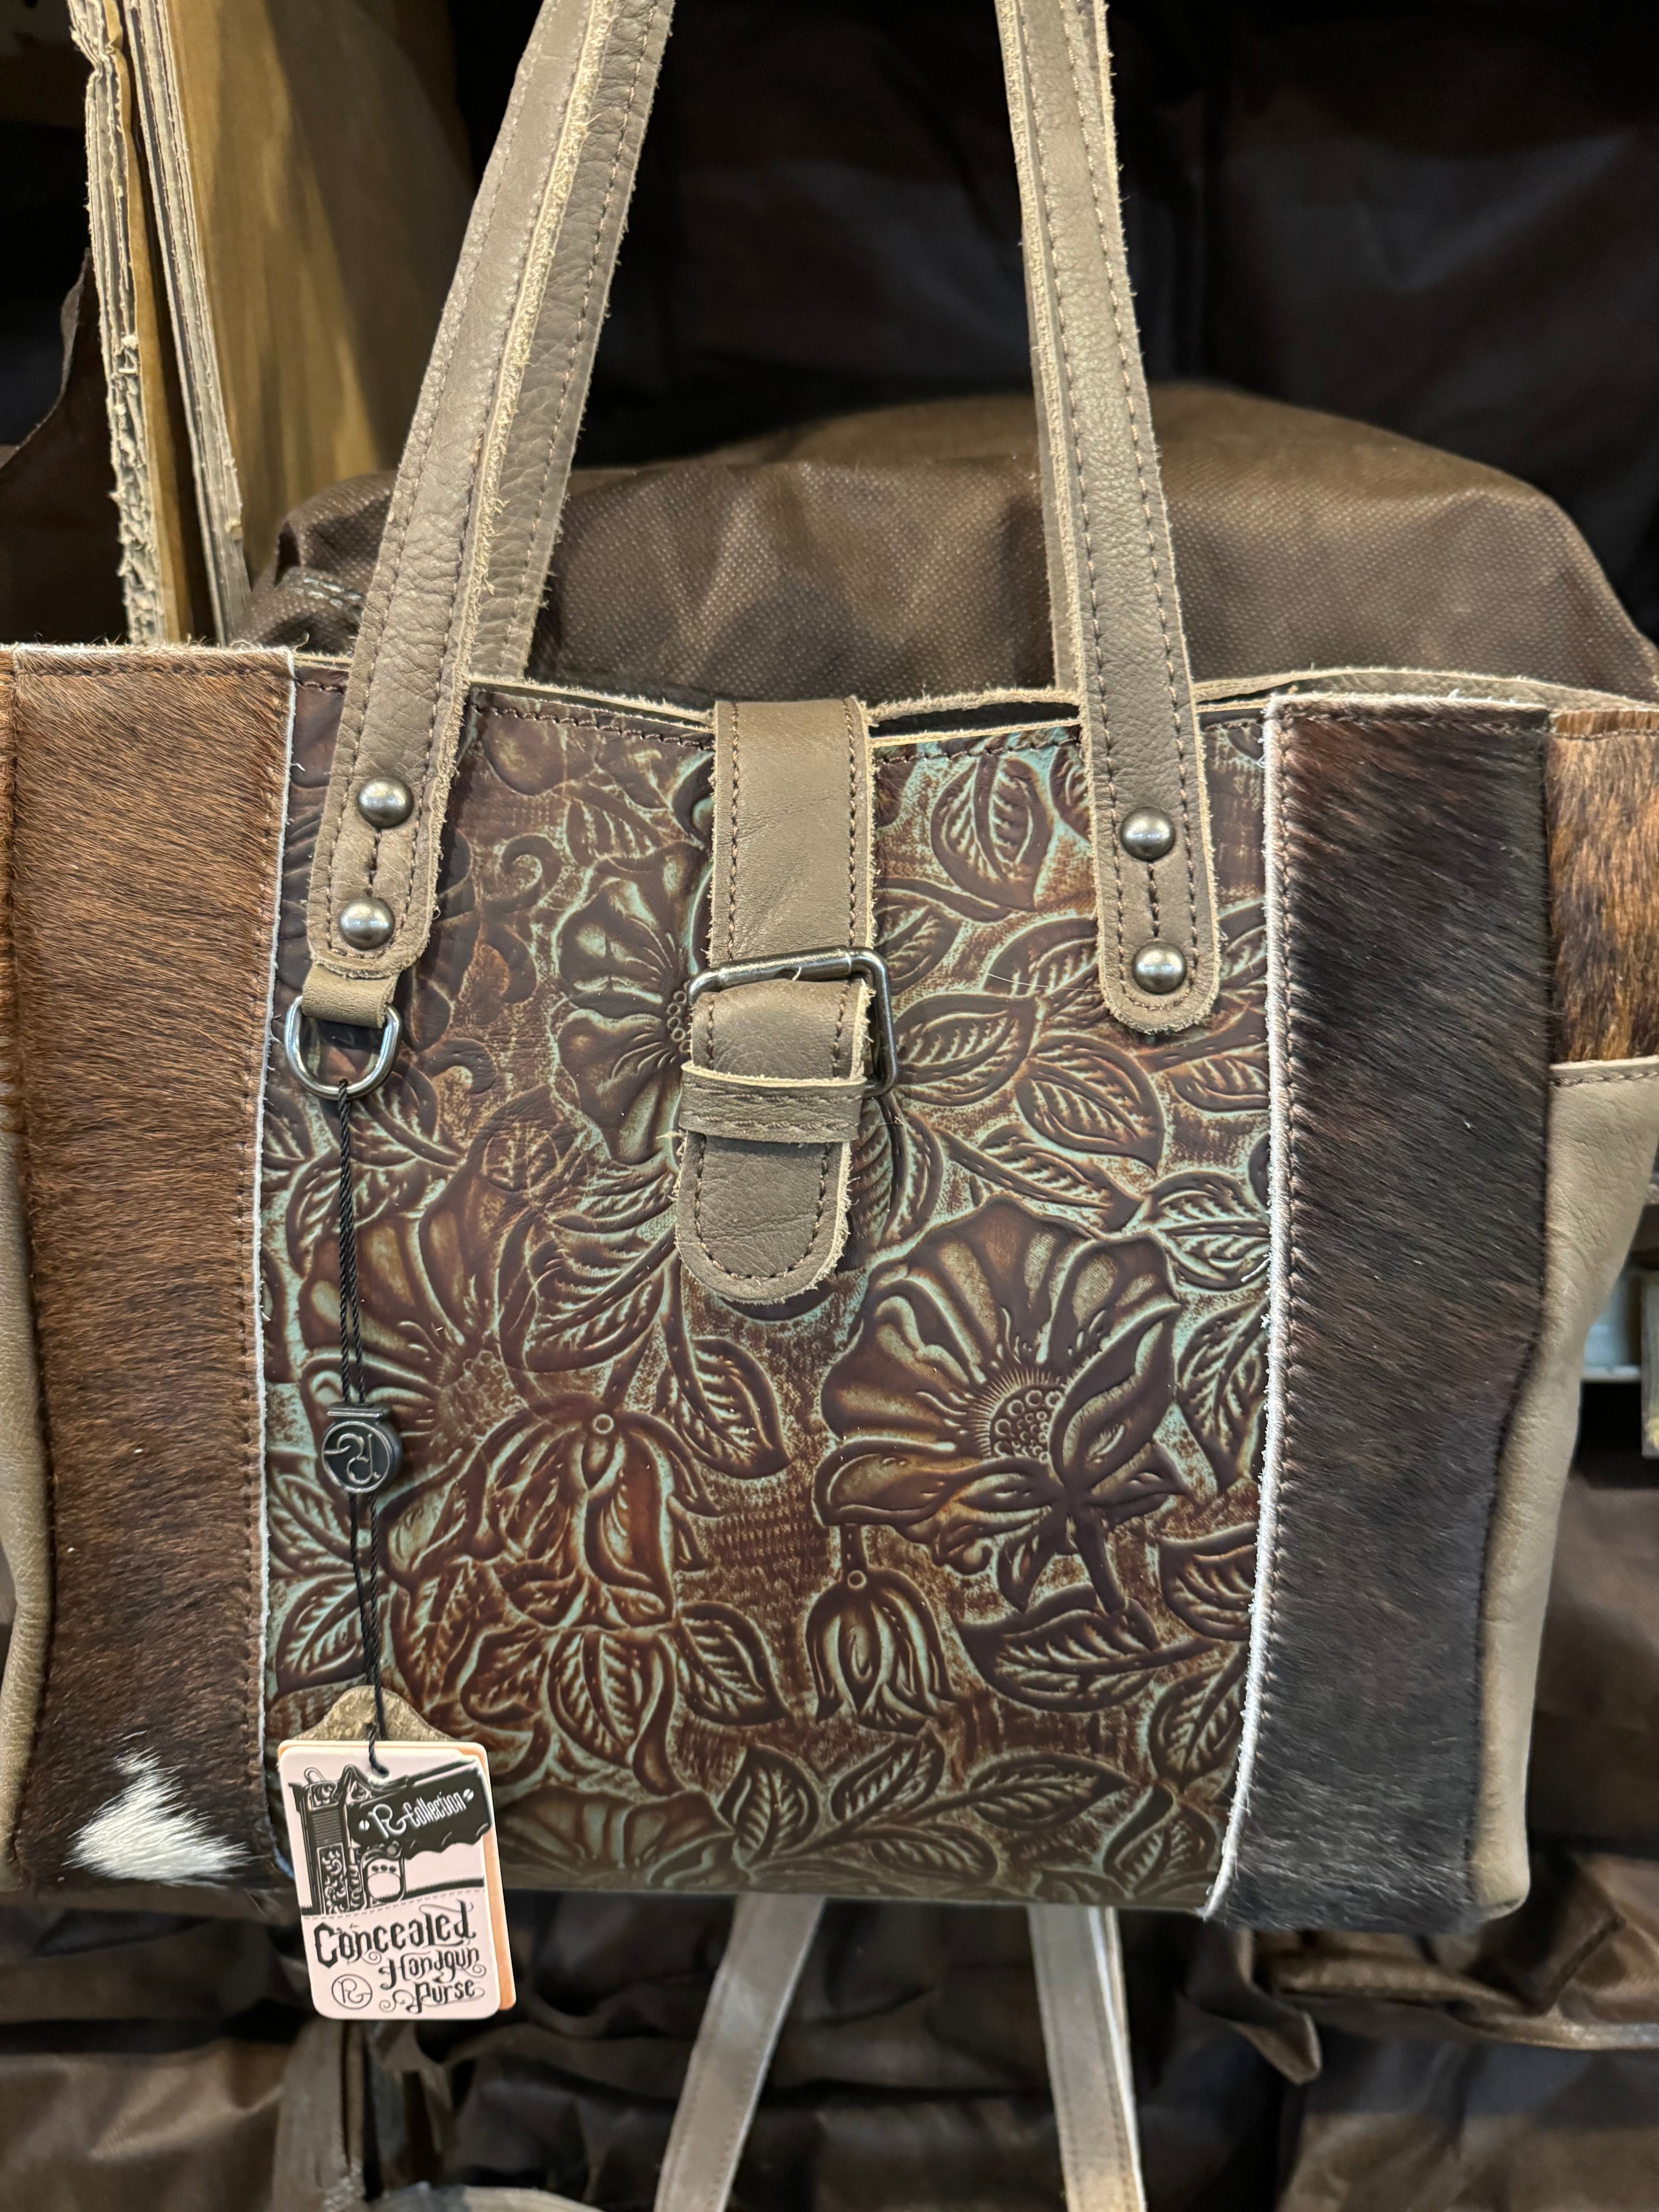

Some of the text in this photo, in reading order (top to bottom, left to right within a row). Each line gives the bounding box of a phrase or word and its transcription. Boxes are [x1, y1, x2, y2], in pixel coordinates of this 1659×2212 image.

[403, 1790, 467, 1828] Collection
[313, 1899, 477, 1968] Concealed
[378, 1947, 485, 1990] Handgun
[393, 1979, 480, 2014] Purse
